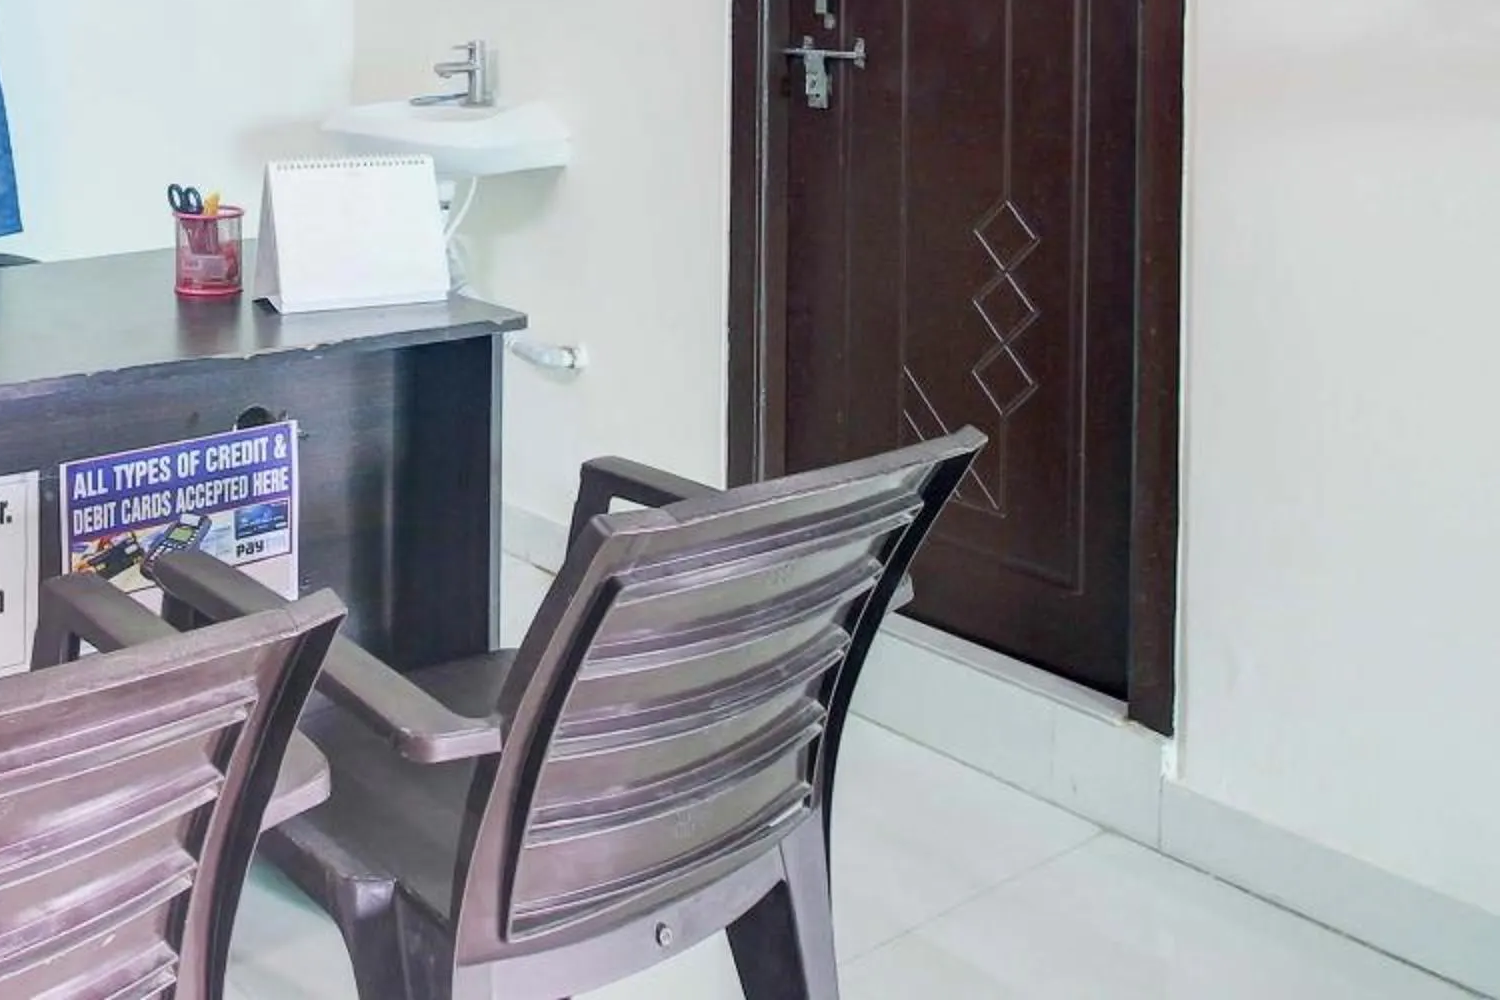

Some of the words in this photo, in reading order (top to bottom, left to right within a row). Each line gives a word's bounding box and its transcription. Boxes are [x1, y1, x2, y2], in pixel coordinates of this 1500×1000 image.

[73, 469, 109, 500] ALL
[112, 455, 172, 491] TYPES
[177, 450, 201, 479] OF
[205, 436, 269, 473] CREDIT
[273, 433, 288, 458] &
[73, 502, 117, 536] DEBIT
[121, 491, 172, 524] CARDS
[175, 475, 249, 514] ACCEPTED
[252, 466, 290, 497] HERE
